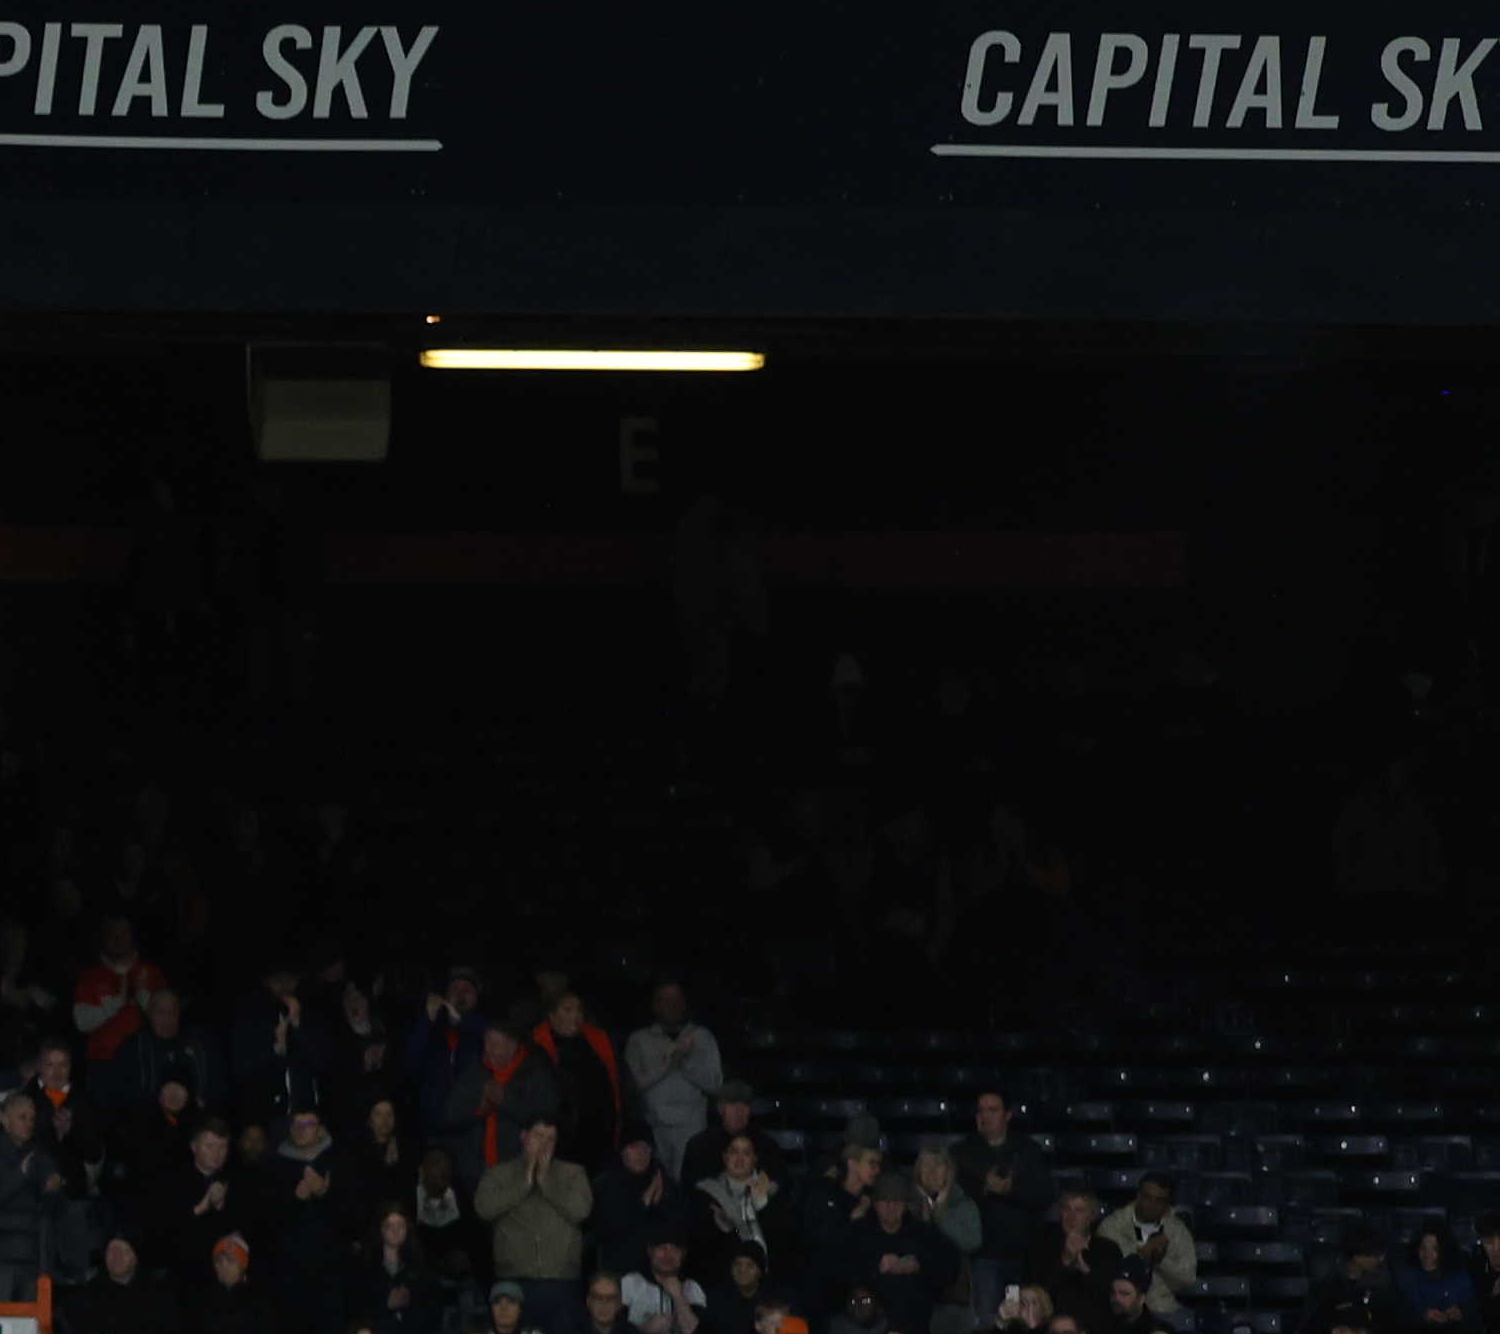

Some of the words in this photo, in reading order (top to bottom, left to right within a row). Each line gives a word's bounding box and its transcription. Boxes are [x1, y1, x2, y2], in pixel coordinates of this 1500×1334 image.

[257, 25, 438, 119] SKY
[962, 31, 1340, 128] CAPITAL
[1372, 37, 1498, 130] SK
[619, 417, 658, 492] E
